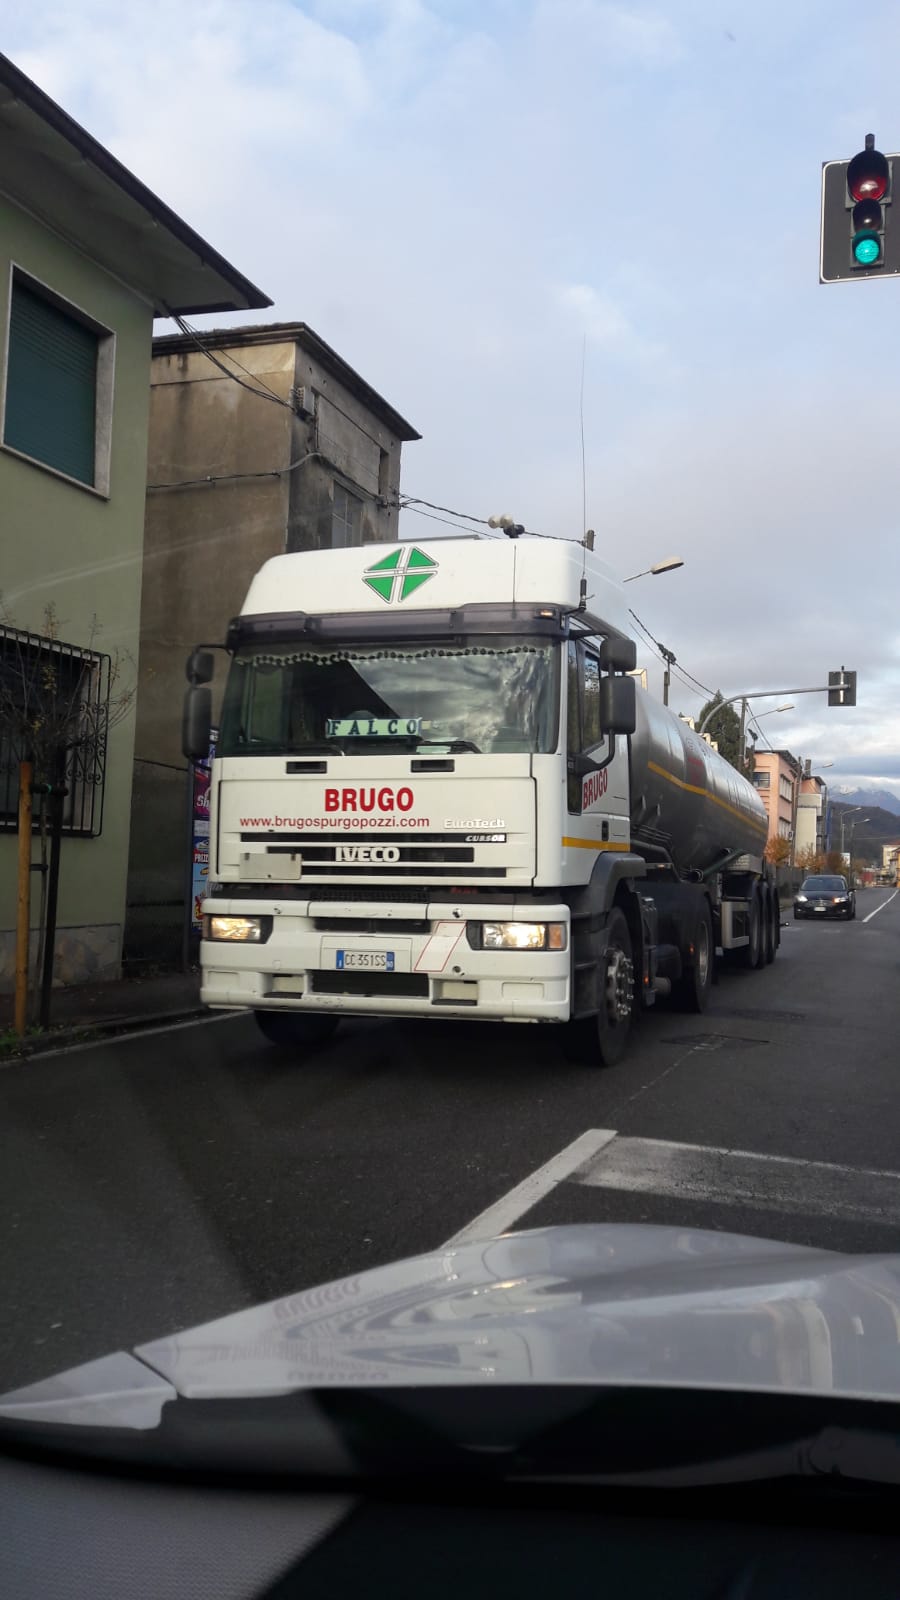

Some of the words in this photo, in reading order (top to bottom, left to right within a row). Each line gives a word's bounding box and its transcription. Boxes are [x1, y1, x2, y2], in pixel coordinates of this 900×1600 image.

[330, 719, 417, 736] FALCO
[582, 767, 608, 810] BRUGO
[324, 787, 414, 812] BRUGO
[240, 815, 430, 830] www.brugospurgopozzi.com
[443, 818, 505, 829] EuroTech
[335, 847, 400, 862] IVECO
